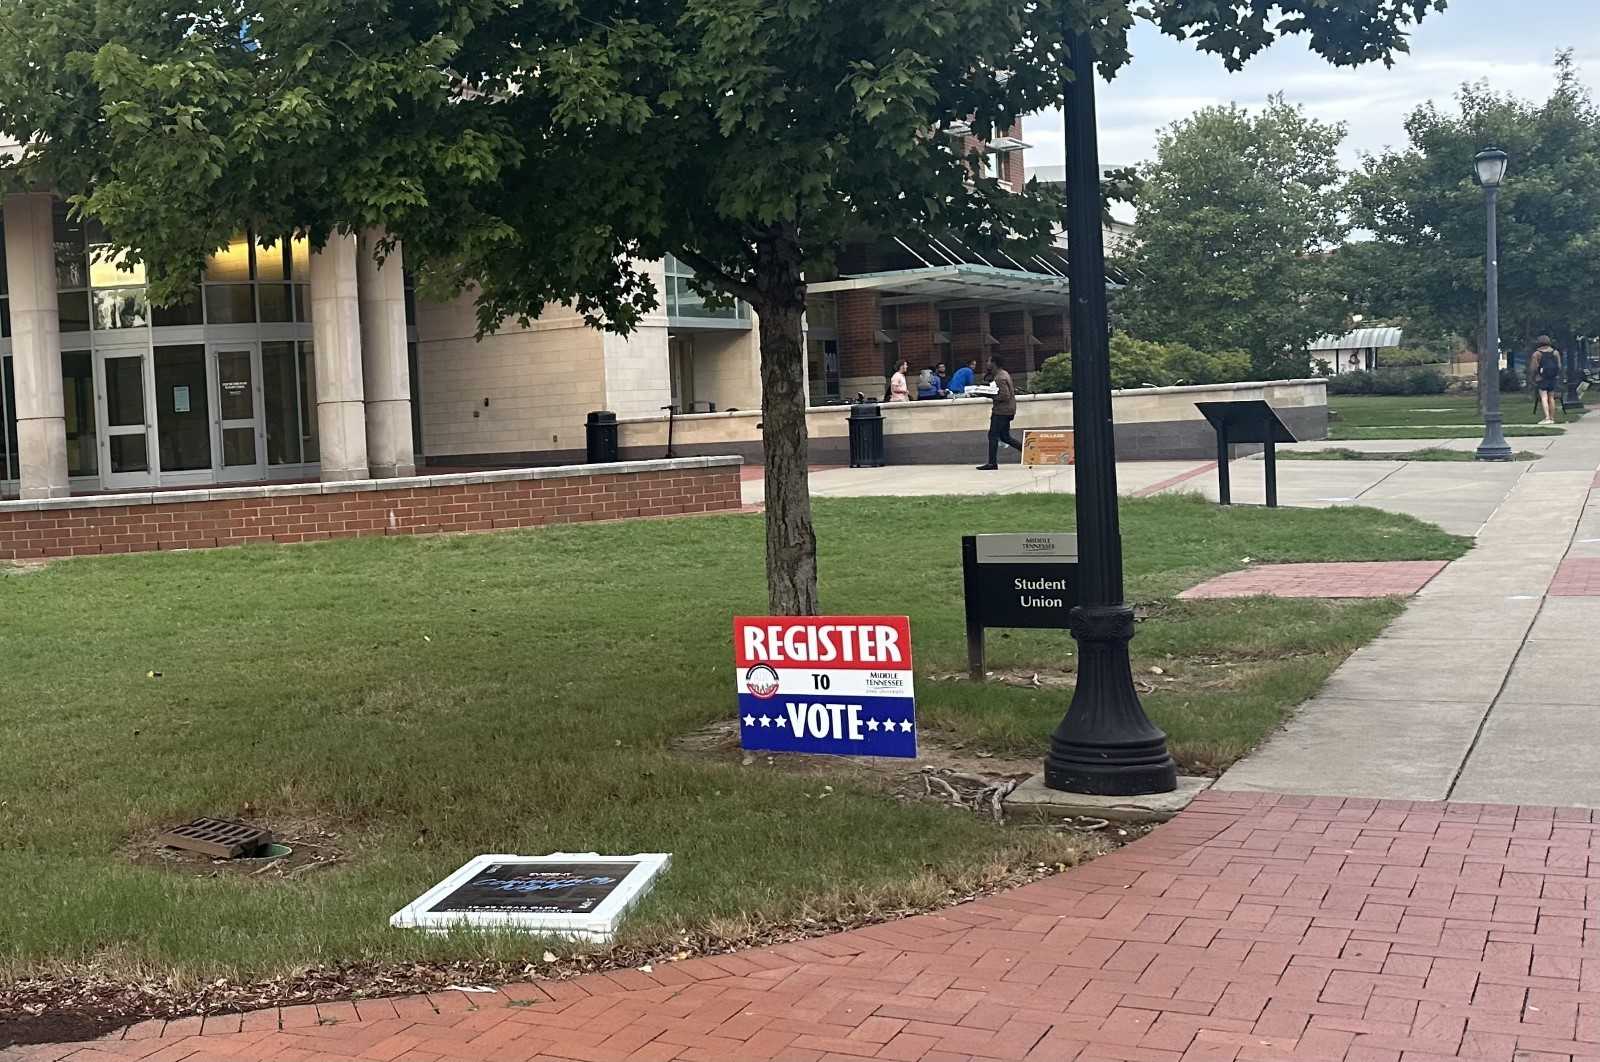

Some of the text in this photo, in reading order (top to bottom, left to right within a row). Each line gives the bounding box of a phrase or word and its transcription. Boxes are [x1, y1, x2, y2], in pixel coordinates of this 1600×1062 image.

[1014, 577, 1066, 590] Student
[1020, 595, 1063, 608] Union
[743, 625, 902, 662] REGISTER
[812, 674, 831, 690] TO
[866, 679, 904, 687] TENNESSEE
[785, 702, 864, 740] VOTE
